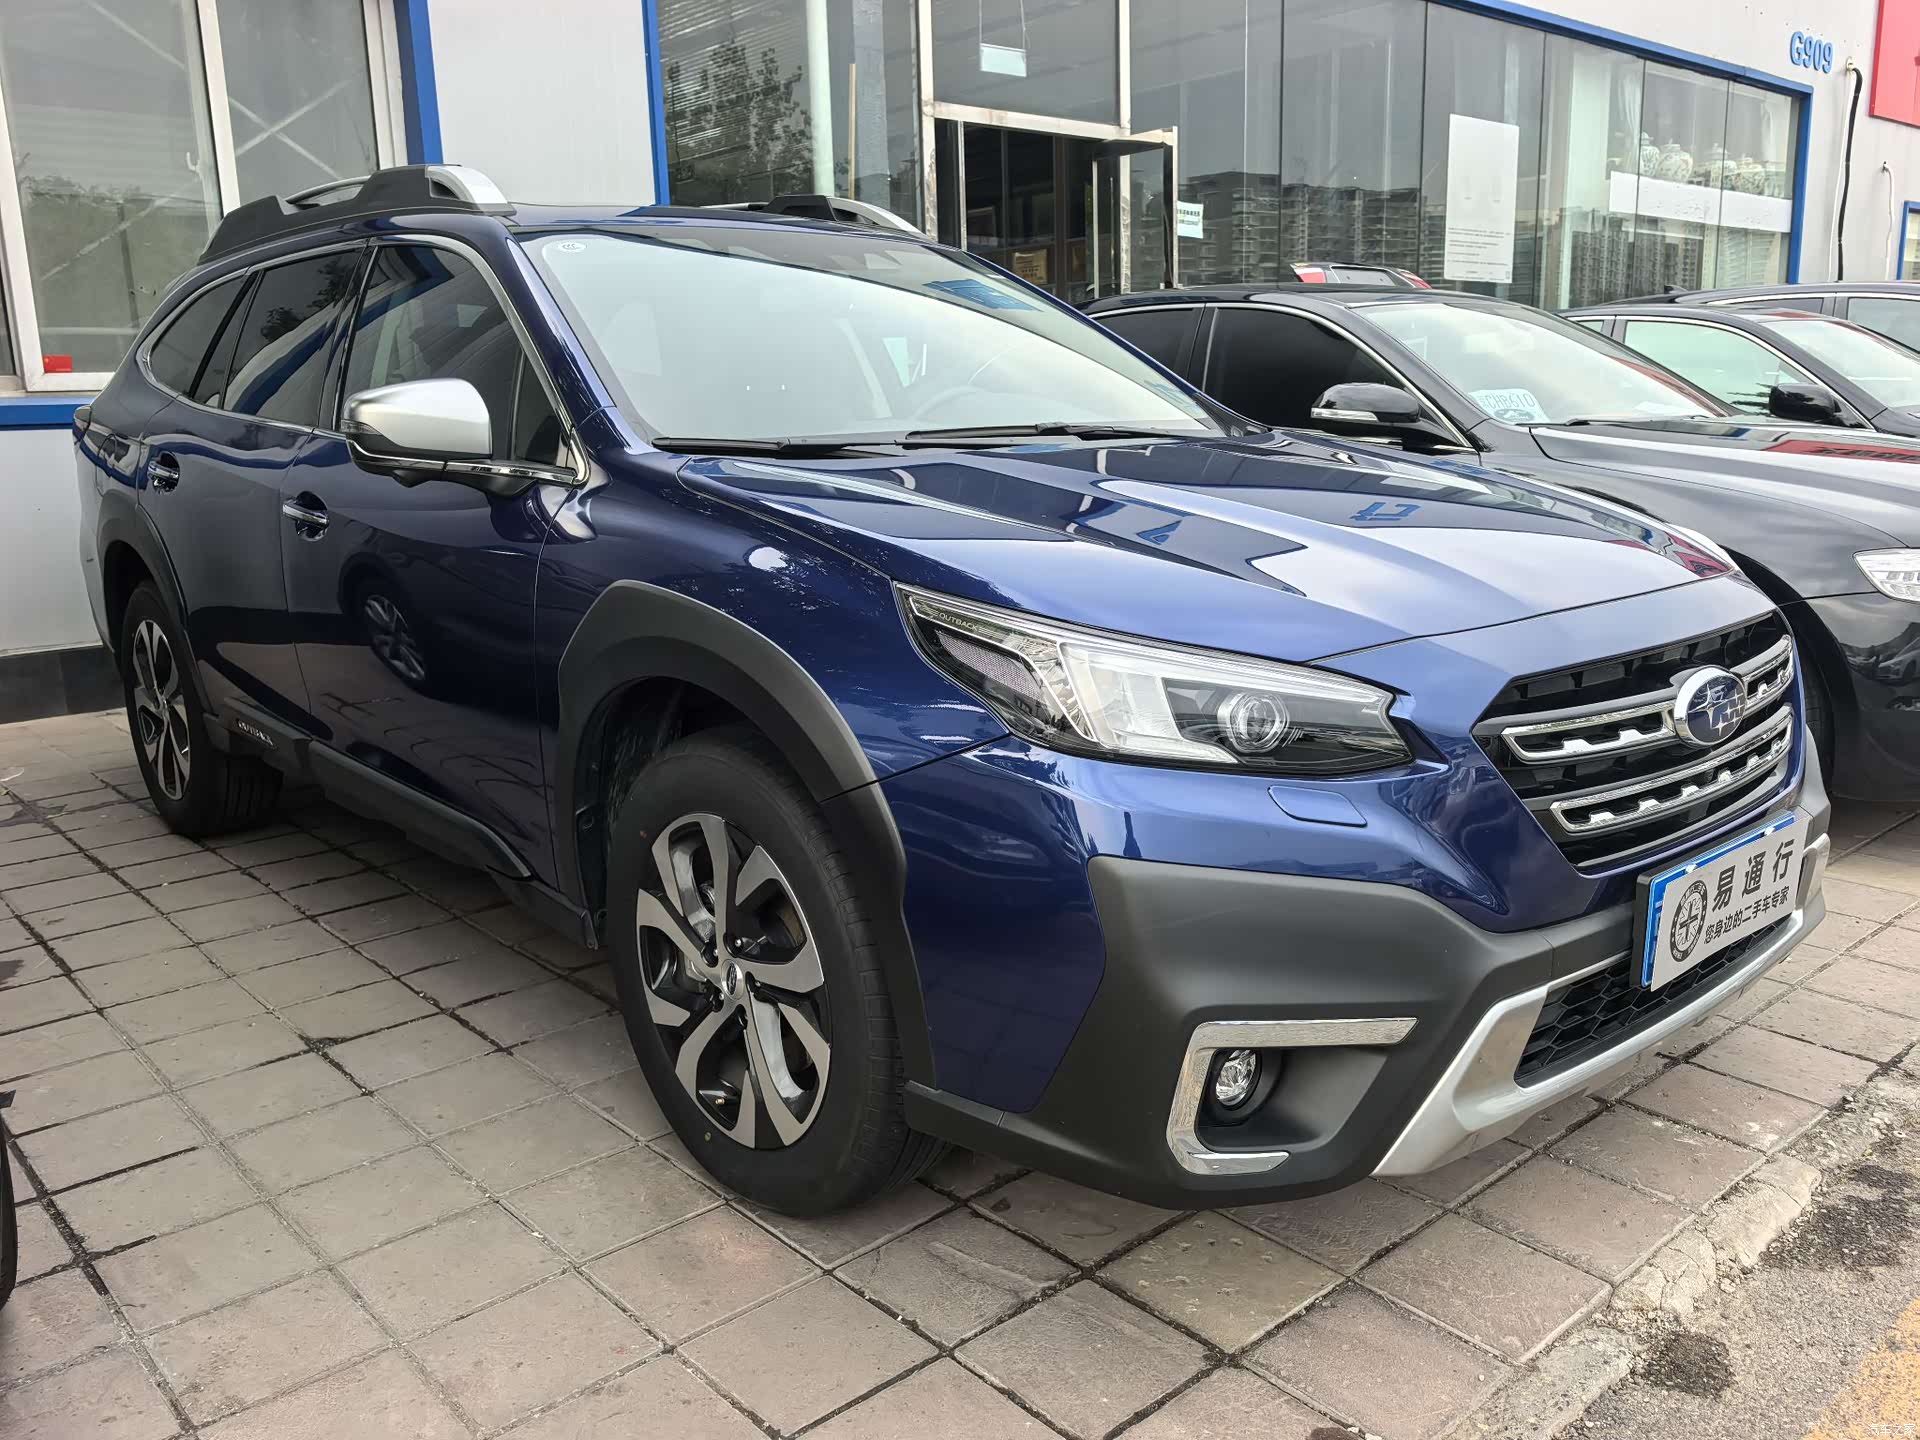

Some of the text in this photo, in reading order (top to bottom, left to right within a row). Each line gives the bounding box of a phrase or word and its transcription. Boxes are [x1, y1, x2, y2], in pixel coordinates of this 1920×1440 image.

[1790, 31, 1833, 74] G909
[938, 611, 978, 633] OUTBACK
[1712, 838, 1795, 912] 易通行
[1704, 886, 1790, 944] 您身边的二手车专家
